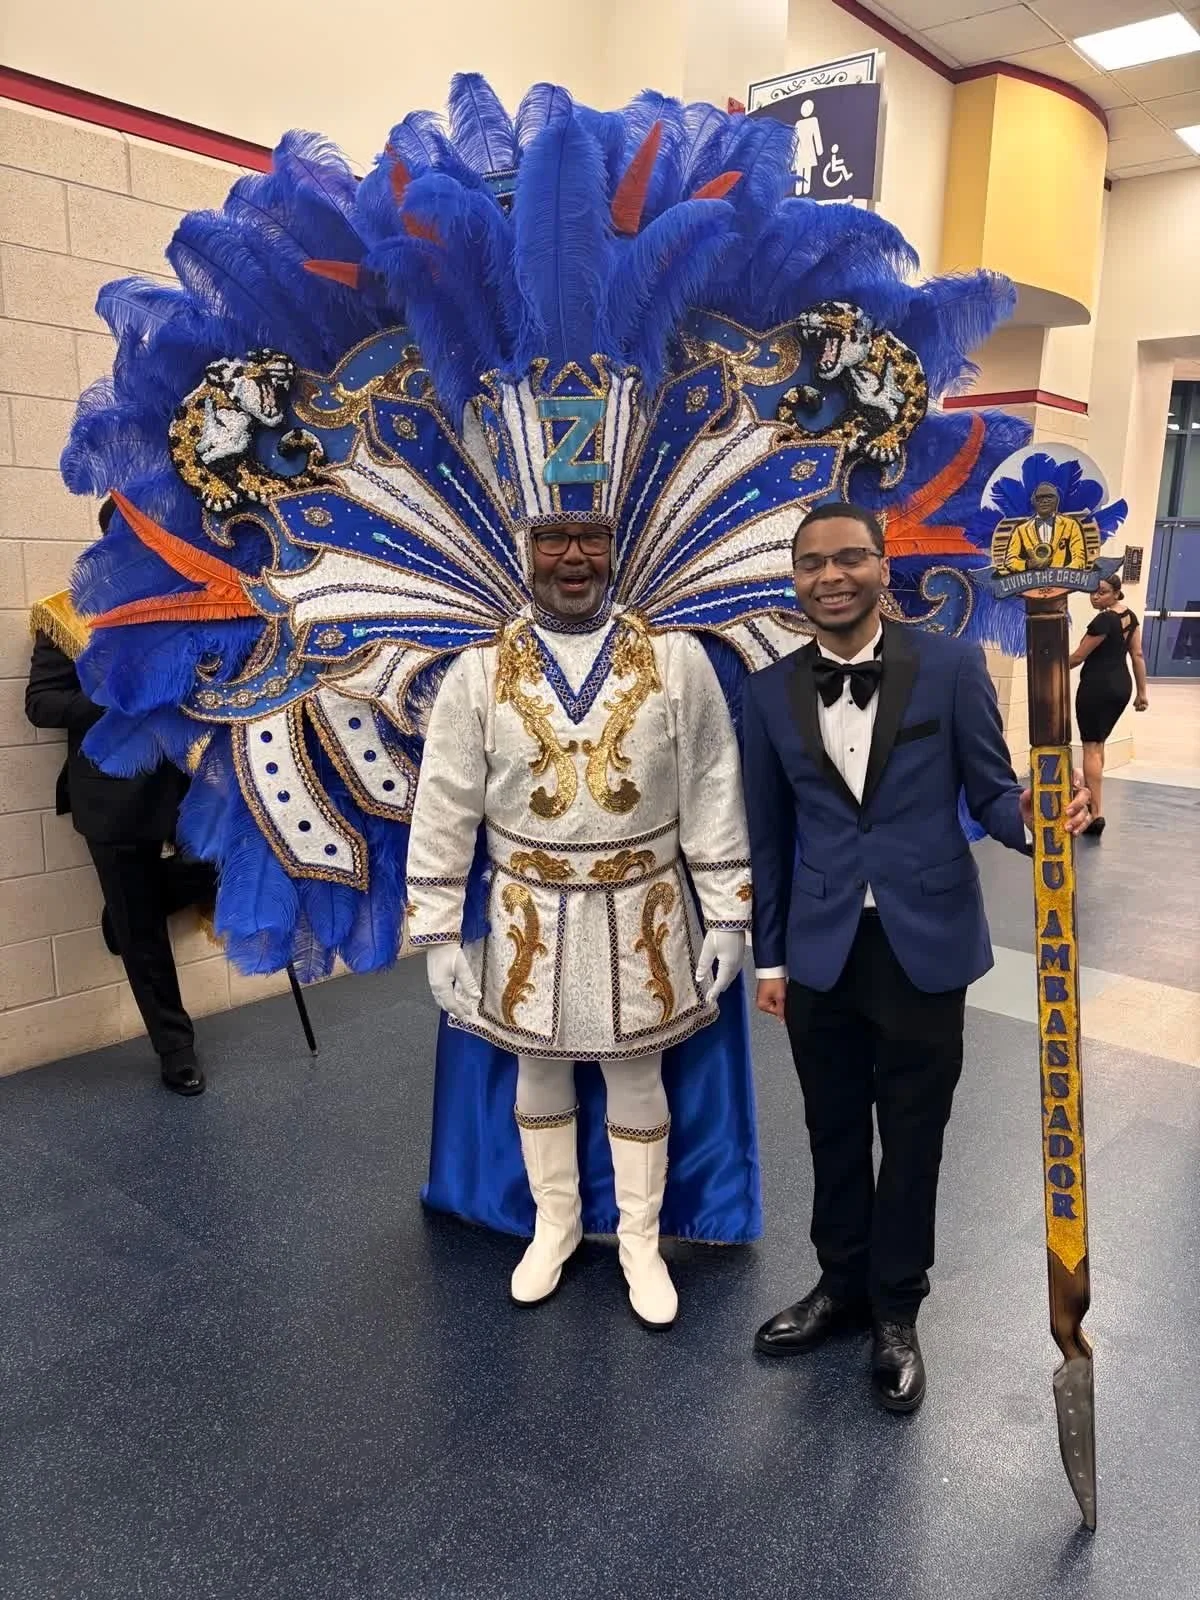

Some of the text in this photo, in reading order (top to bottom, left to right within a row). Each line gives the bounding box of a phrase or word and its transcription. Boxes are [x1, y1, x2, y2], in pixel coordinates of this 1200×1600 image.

[538, 399, 609, 484] Z
[1001, 573, 1033, 592] LIVING
[1035, 571, 1054, 584] THE
[1056, 570, 1089, 586] DREAM
[1037, 753, 1078, 1220] ZULU AMBASSADOR
